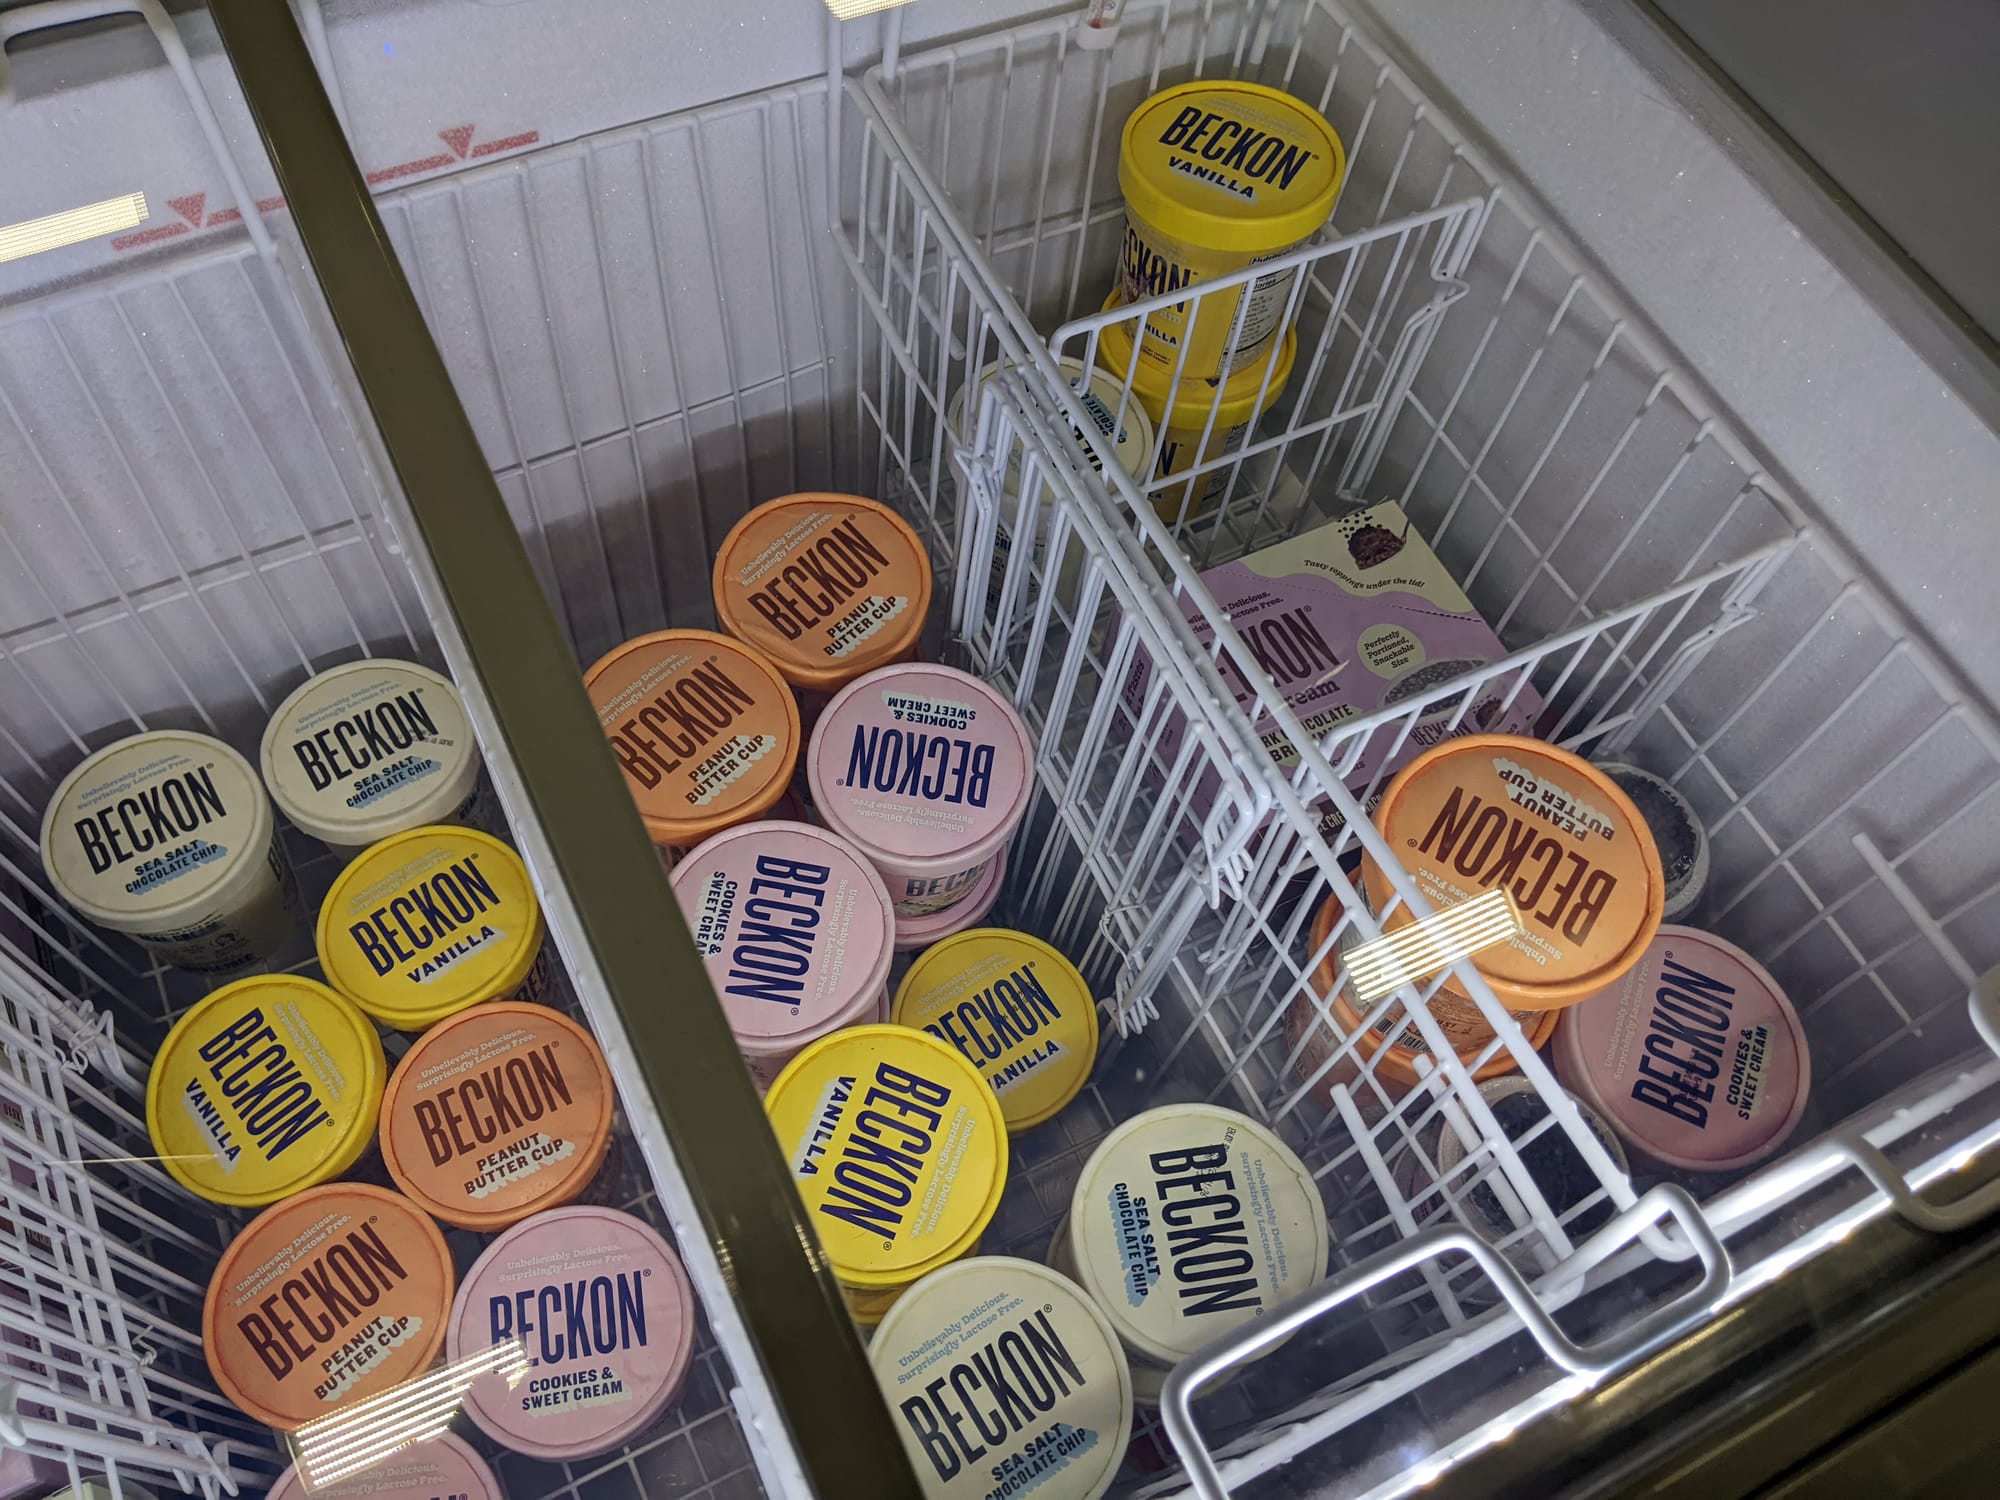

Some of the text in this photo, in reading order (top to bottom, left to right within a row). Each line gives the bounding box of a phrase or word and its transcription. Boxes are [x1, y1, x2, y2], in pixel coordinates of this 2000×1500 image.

[1159, 106, 1311, 190] BECKON
[1169, 156, 1254, 198] VANILLA
[1145, 323, 1176, 345] NILLA
[748, 519, 889, 640] BECKON
[1227, 592, 1271, 612] Delicious.
[1304, 559, 1328, 569] Tasty
[1330, 567, 1364, 589] toppings
[1366, 579, 1391, 589] under
[1408, 579, 1425, 587] lid!
[823, 596, 897, 656] BUTTER CUP
[827, 596, 875, 638] PEANUT
[1231, 603, 1259, 620] actose
[1364, 630, 1400, 650] Perfectly
[1367, 637, 1409, 659] Portioned,
[1373, 644, 1414, 666] Snackable
[1391, 657, 1408, 668] Size
[598, 680, 642, 716] nbelievably
[888, 696, 976, 720] SWEET CREAM
[893, 710, 966, 730] COOKIES &
[1283, 680, 1340, 707] ream
[293, 691, 438, 792] BECKON
[608, 660, 755, 790] BECKON
[346, 759, 433, 807] CHOCOLATE CHIP
[354, 756, 414, 790] SEA SALT
[685, 735, 764, 805] BUTTER CUP
[688, 736, 742, 783] PEANUT
[846, 725, 995, 808] BECKON
[74, 766, 227, 875] BECKON
[1499, 769, 1615, 841] BUTTER CUP
[1511, 792, 1588, 842] PEANUT
[125, 844, 218, 894] CHOCOLATE CHIP
[135, 840, 200, 875] SEA SALT
[1418, 786, 1618, 948] BECKON
[1419, 867, 1445, 889] Free.
[350, 857, 500, 977] BECKON
[707, 872, 725, 914] SWEET
[708, 881, 738, 955] COOKIES &
[407, 926, 495, 982] VANILLA
[725, 855, 830, 1006] BECKON
[1631, 957, 1736, 1128] BECKON
[1727, 1029, 1753, 1105] COOKIES &
[199, 1007, 329, 1161] BECKON
[1738, 1027, 1767, 1120] SWEET CREAM
[185, 1077, 242, 1161] VANILLA
[413, 1044, 573, 1167] BECKON
[799, 1076, 857, 1175] VANILLA
[464, 1138, 563, 1195] BUTTER CUP
[476, 1133, 540, 1171] PEANUT
[819, 1062, 951, 1240] BECKON
[1114, 1183, 1148, 1296] CHOCOLATE CHIP
[1134, 1197, 1161, 1276] SEA SALT
[1150, 1144, 1262, 1317] BECKON
[237, 1222, 408, 1382] BECKON
[899, 1292, 1008, 1366] Unbelievably Delicious.
[314, 1317, 409, 1400] BUTTER CUP
[321, 1317, 385, 1373] PEANUT
[898, 1297, 1024, 1384] Surprisingly Lactose Free.
[522, 1380, 623, 1410] SWEET CREAM
[529, 1367, 613, 1393] COOKIES &
[900, 1310, 1086, 1484] BECKON
[992, 1423, 1062, 1481] SEA SALT
[1056, 1428, 1086, 1456] CHIP
